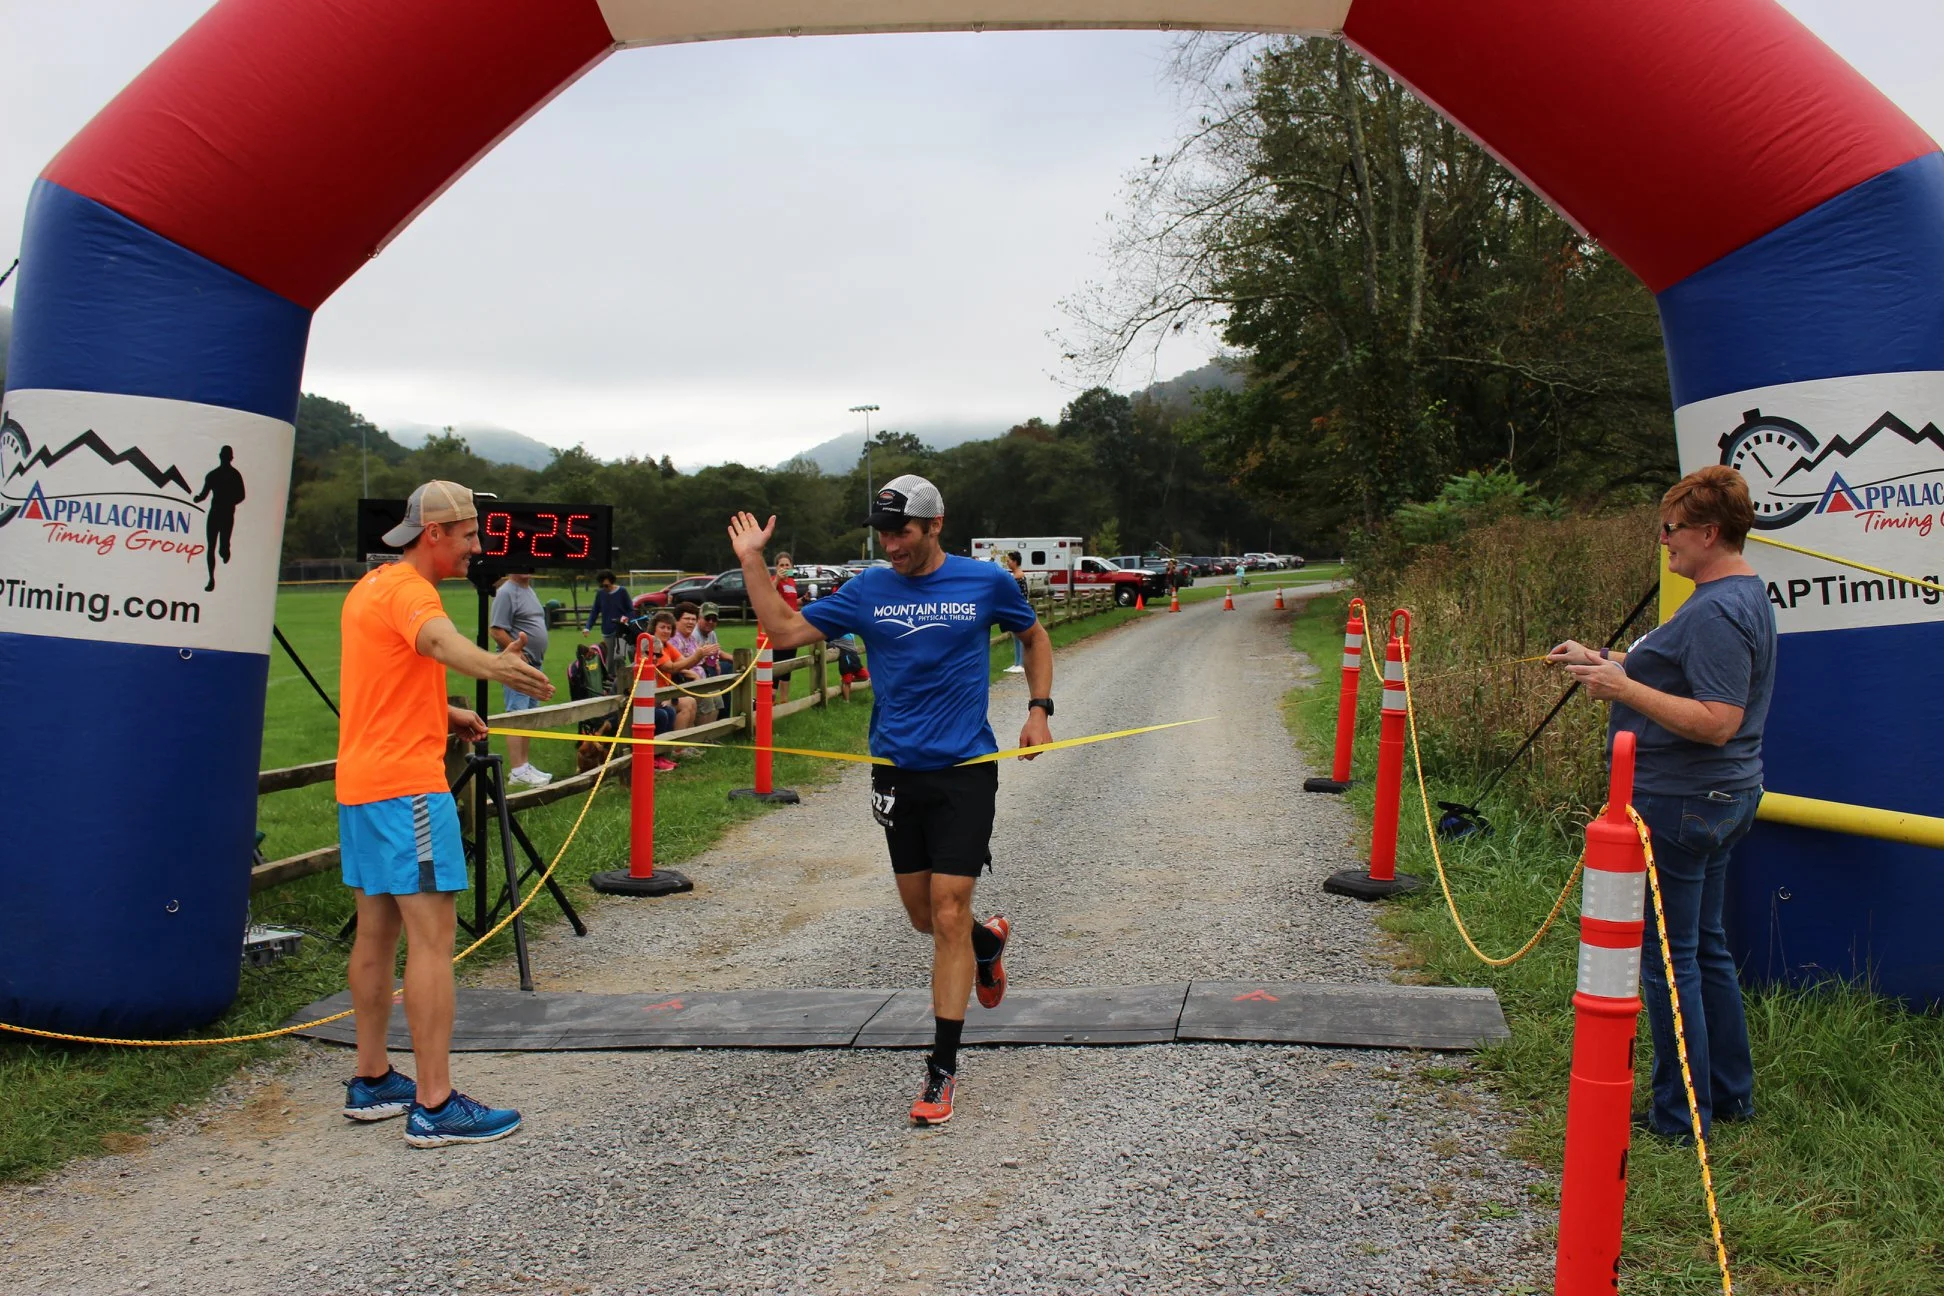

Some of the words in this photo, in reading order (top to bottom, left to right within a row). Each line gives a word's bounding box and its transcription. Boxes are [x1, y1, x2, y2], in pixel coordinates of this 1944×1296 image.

[18, 480, 191, 534] APPALACHIAN
[1854, 510, 1933, 536] Timing
[43, 522, 116, 556] Timing
[125, 530, 205, 563] Group
[874, 603, 937, 617] MOUNTAIN
[941, 602, 977, 616] RIDGE
[918, 614, 947, 622] PHYSICAL
[949, 614, 976, 622] THERAPY
